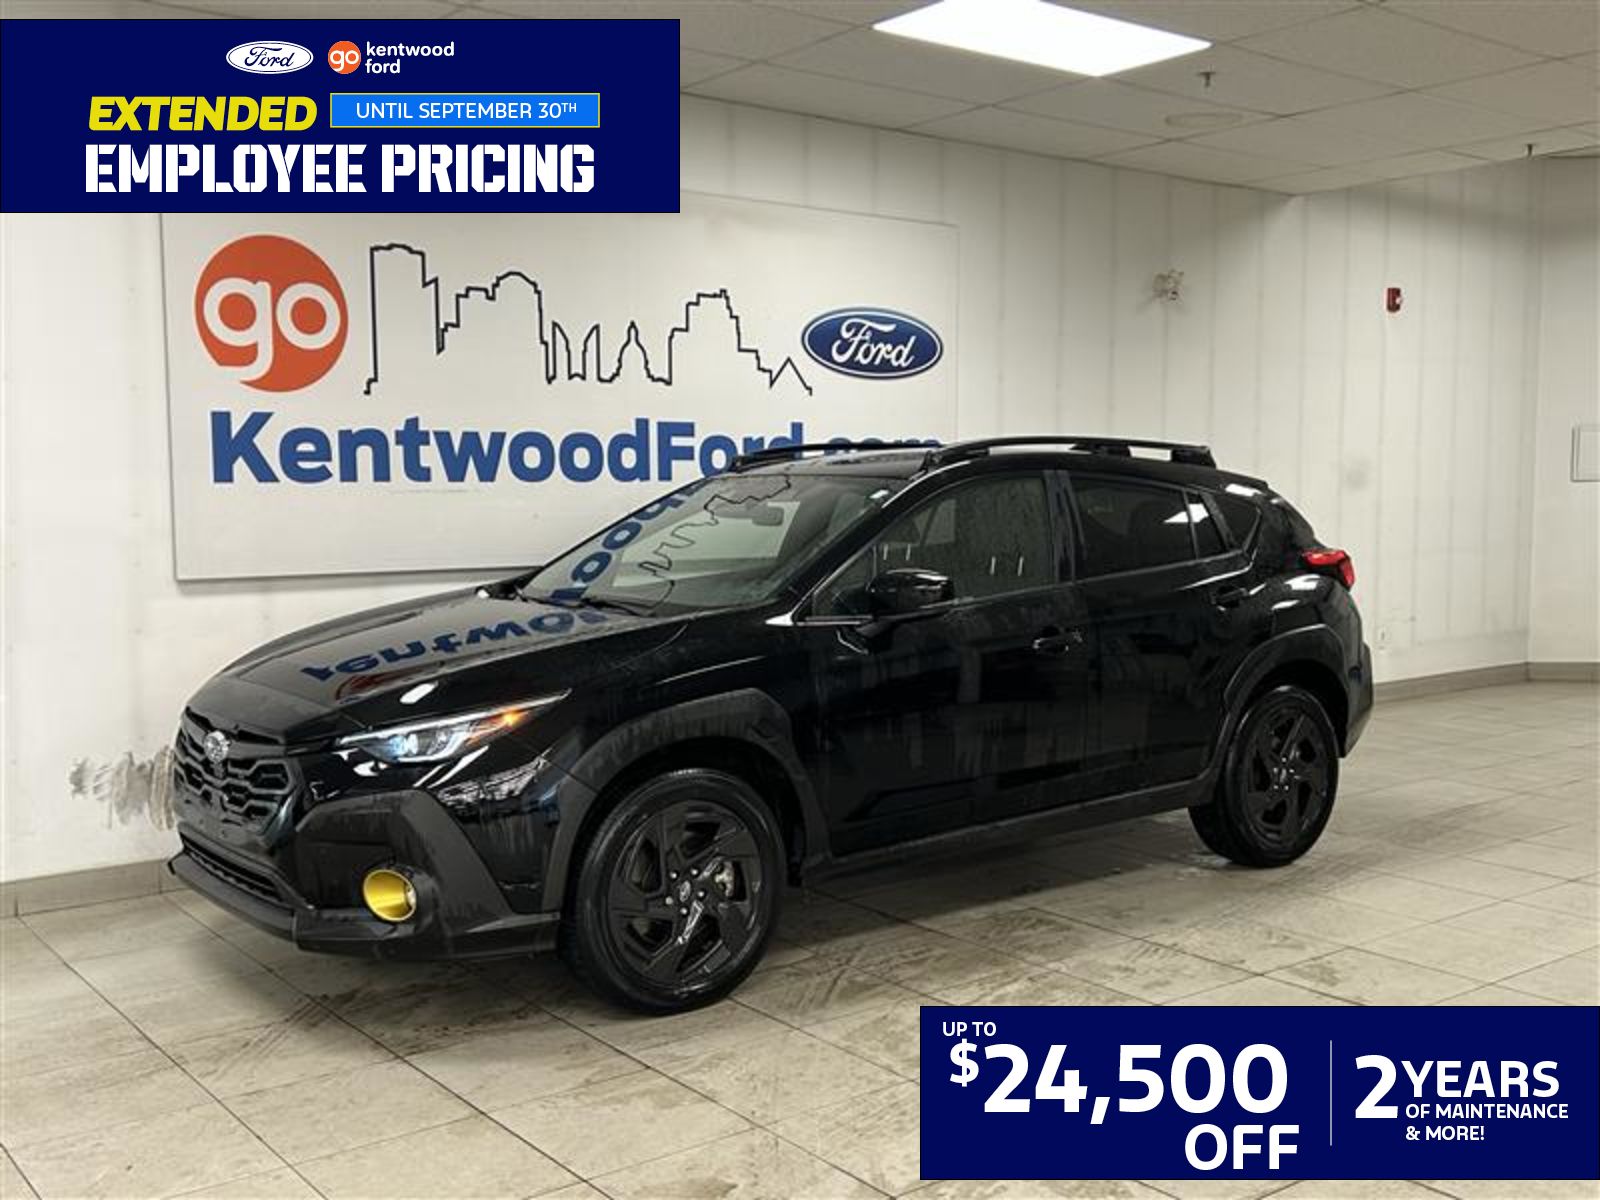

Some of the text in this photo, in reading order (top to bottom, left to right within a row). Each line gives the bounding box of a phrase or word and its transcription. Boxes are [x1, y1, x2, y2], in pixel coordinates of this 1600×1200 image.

[203, 277, 341, 383] go
[831, 318, 917, 367] Ford
[213, 411, 941, 484] KentwoodFo
